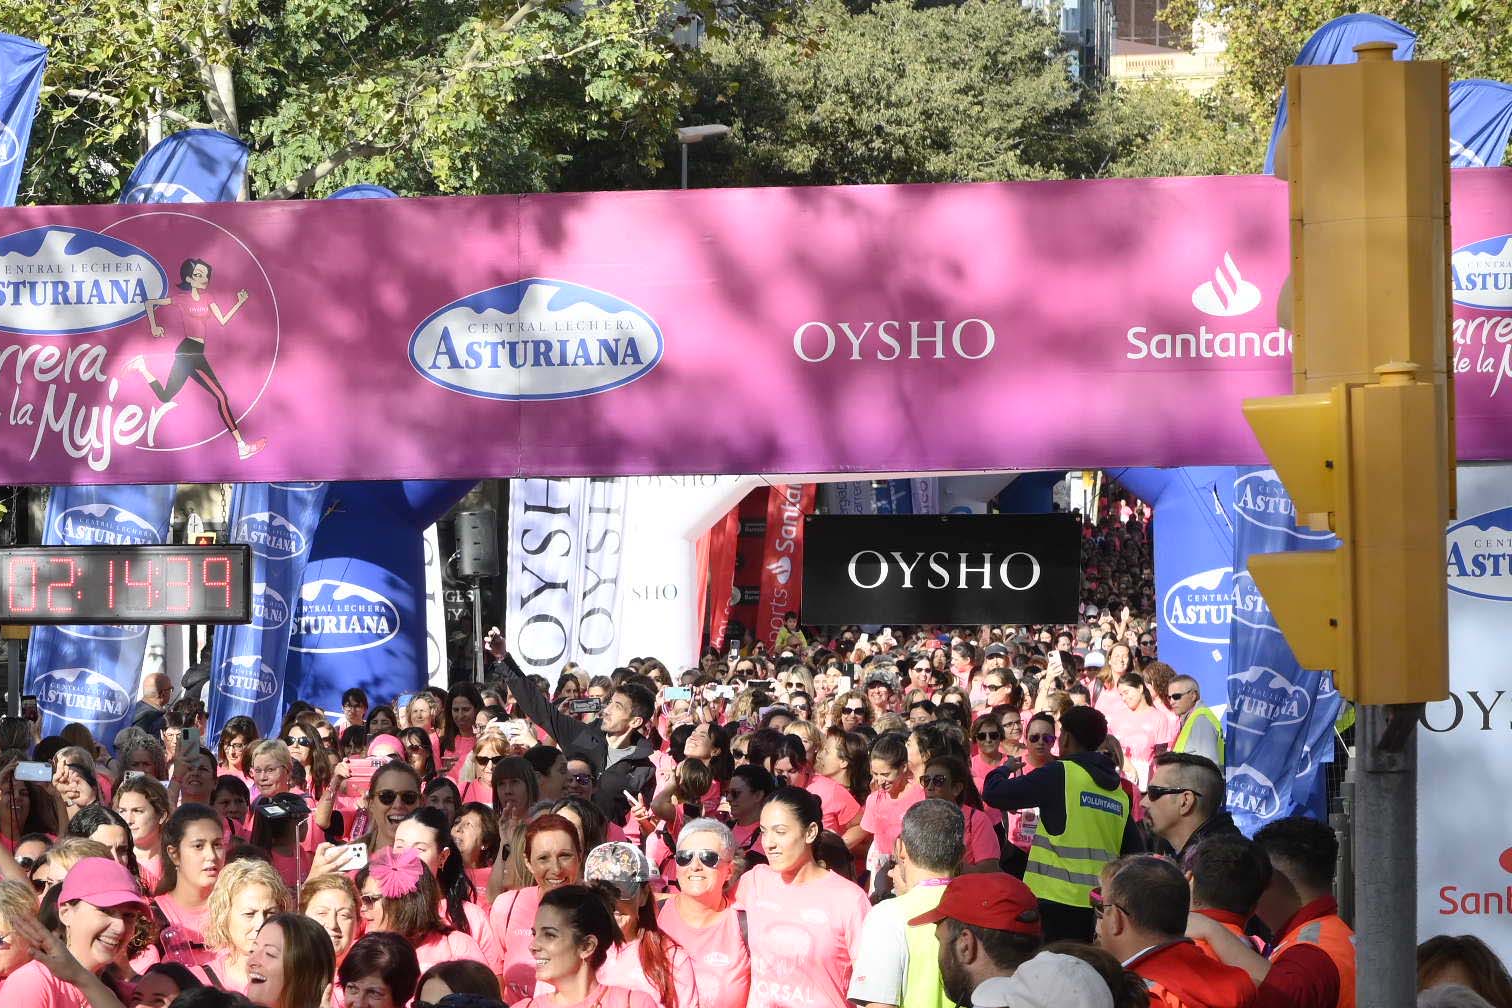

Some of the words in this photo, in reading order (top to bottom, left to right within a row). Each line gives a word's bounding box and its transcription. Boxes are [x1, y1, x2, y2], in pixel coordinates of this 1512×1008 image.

[72, 262, 144, 273] LECHERA
[428, 325, 644, 370] ASTURIANA
[467, 323, 547, 335] CENTRAL
[554, 319, 636, 331] LECHERA
[792, 318, 996, 363] OYSHO
[1476, 349, 1495, 374] la
[9, 386, 34, 426] la
[29, 377, 179, 472] Mujer
[7, 557, 230, 613] 02:14:39
[518, 478, 573, 667] OYSH
[848, 550, 1041, 591] OYSHO
[337, 604, 386, 613] LECHERA
[631, 583, 678, 601] SHO
[1187, 594, 1233, 602] CENTRA
[1420, 690, 1512, 733] OY
